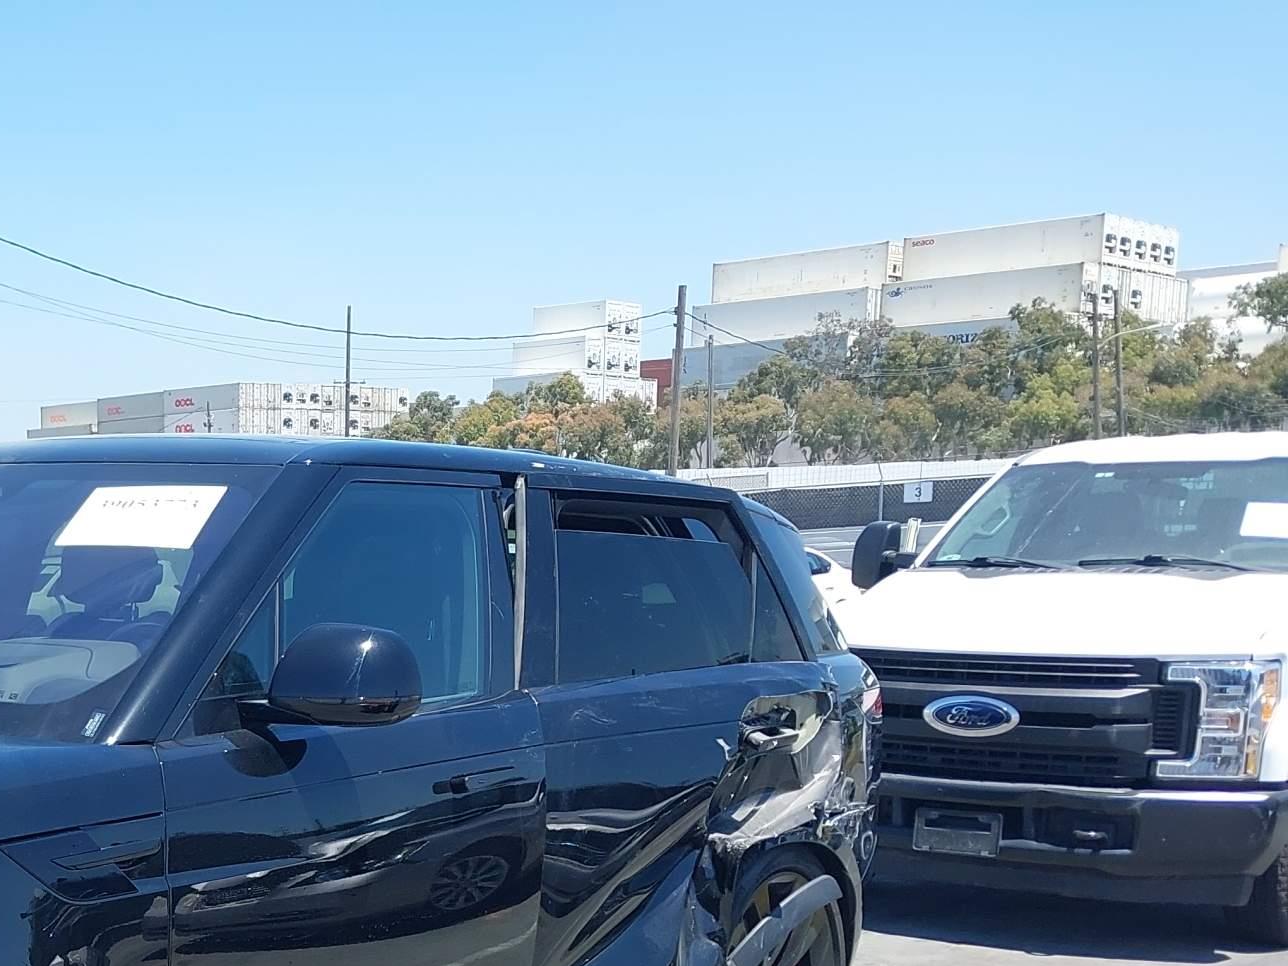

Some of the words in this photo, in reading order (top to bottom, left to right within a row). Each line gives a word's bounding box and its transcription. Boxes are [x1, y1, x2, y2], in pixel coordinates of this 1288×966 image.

[175, 398, 194, 408] OOCL
[914, 487, 922, 498] 3
[946, 705, 993, 726] Ford
